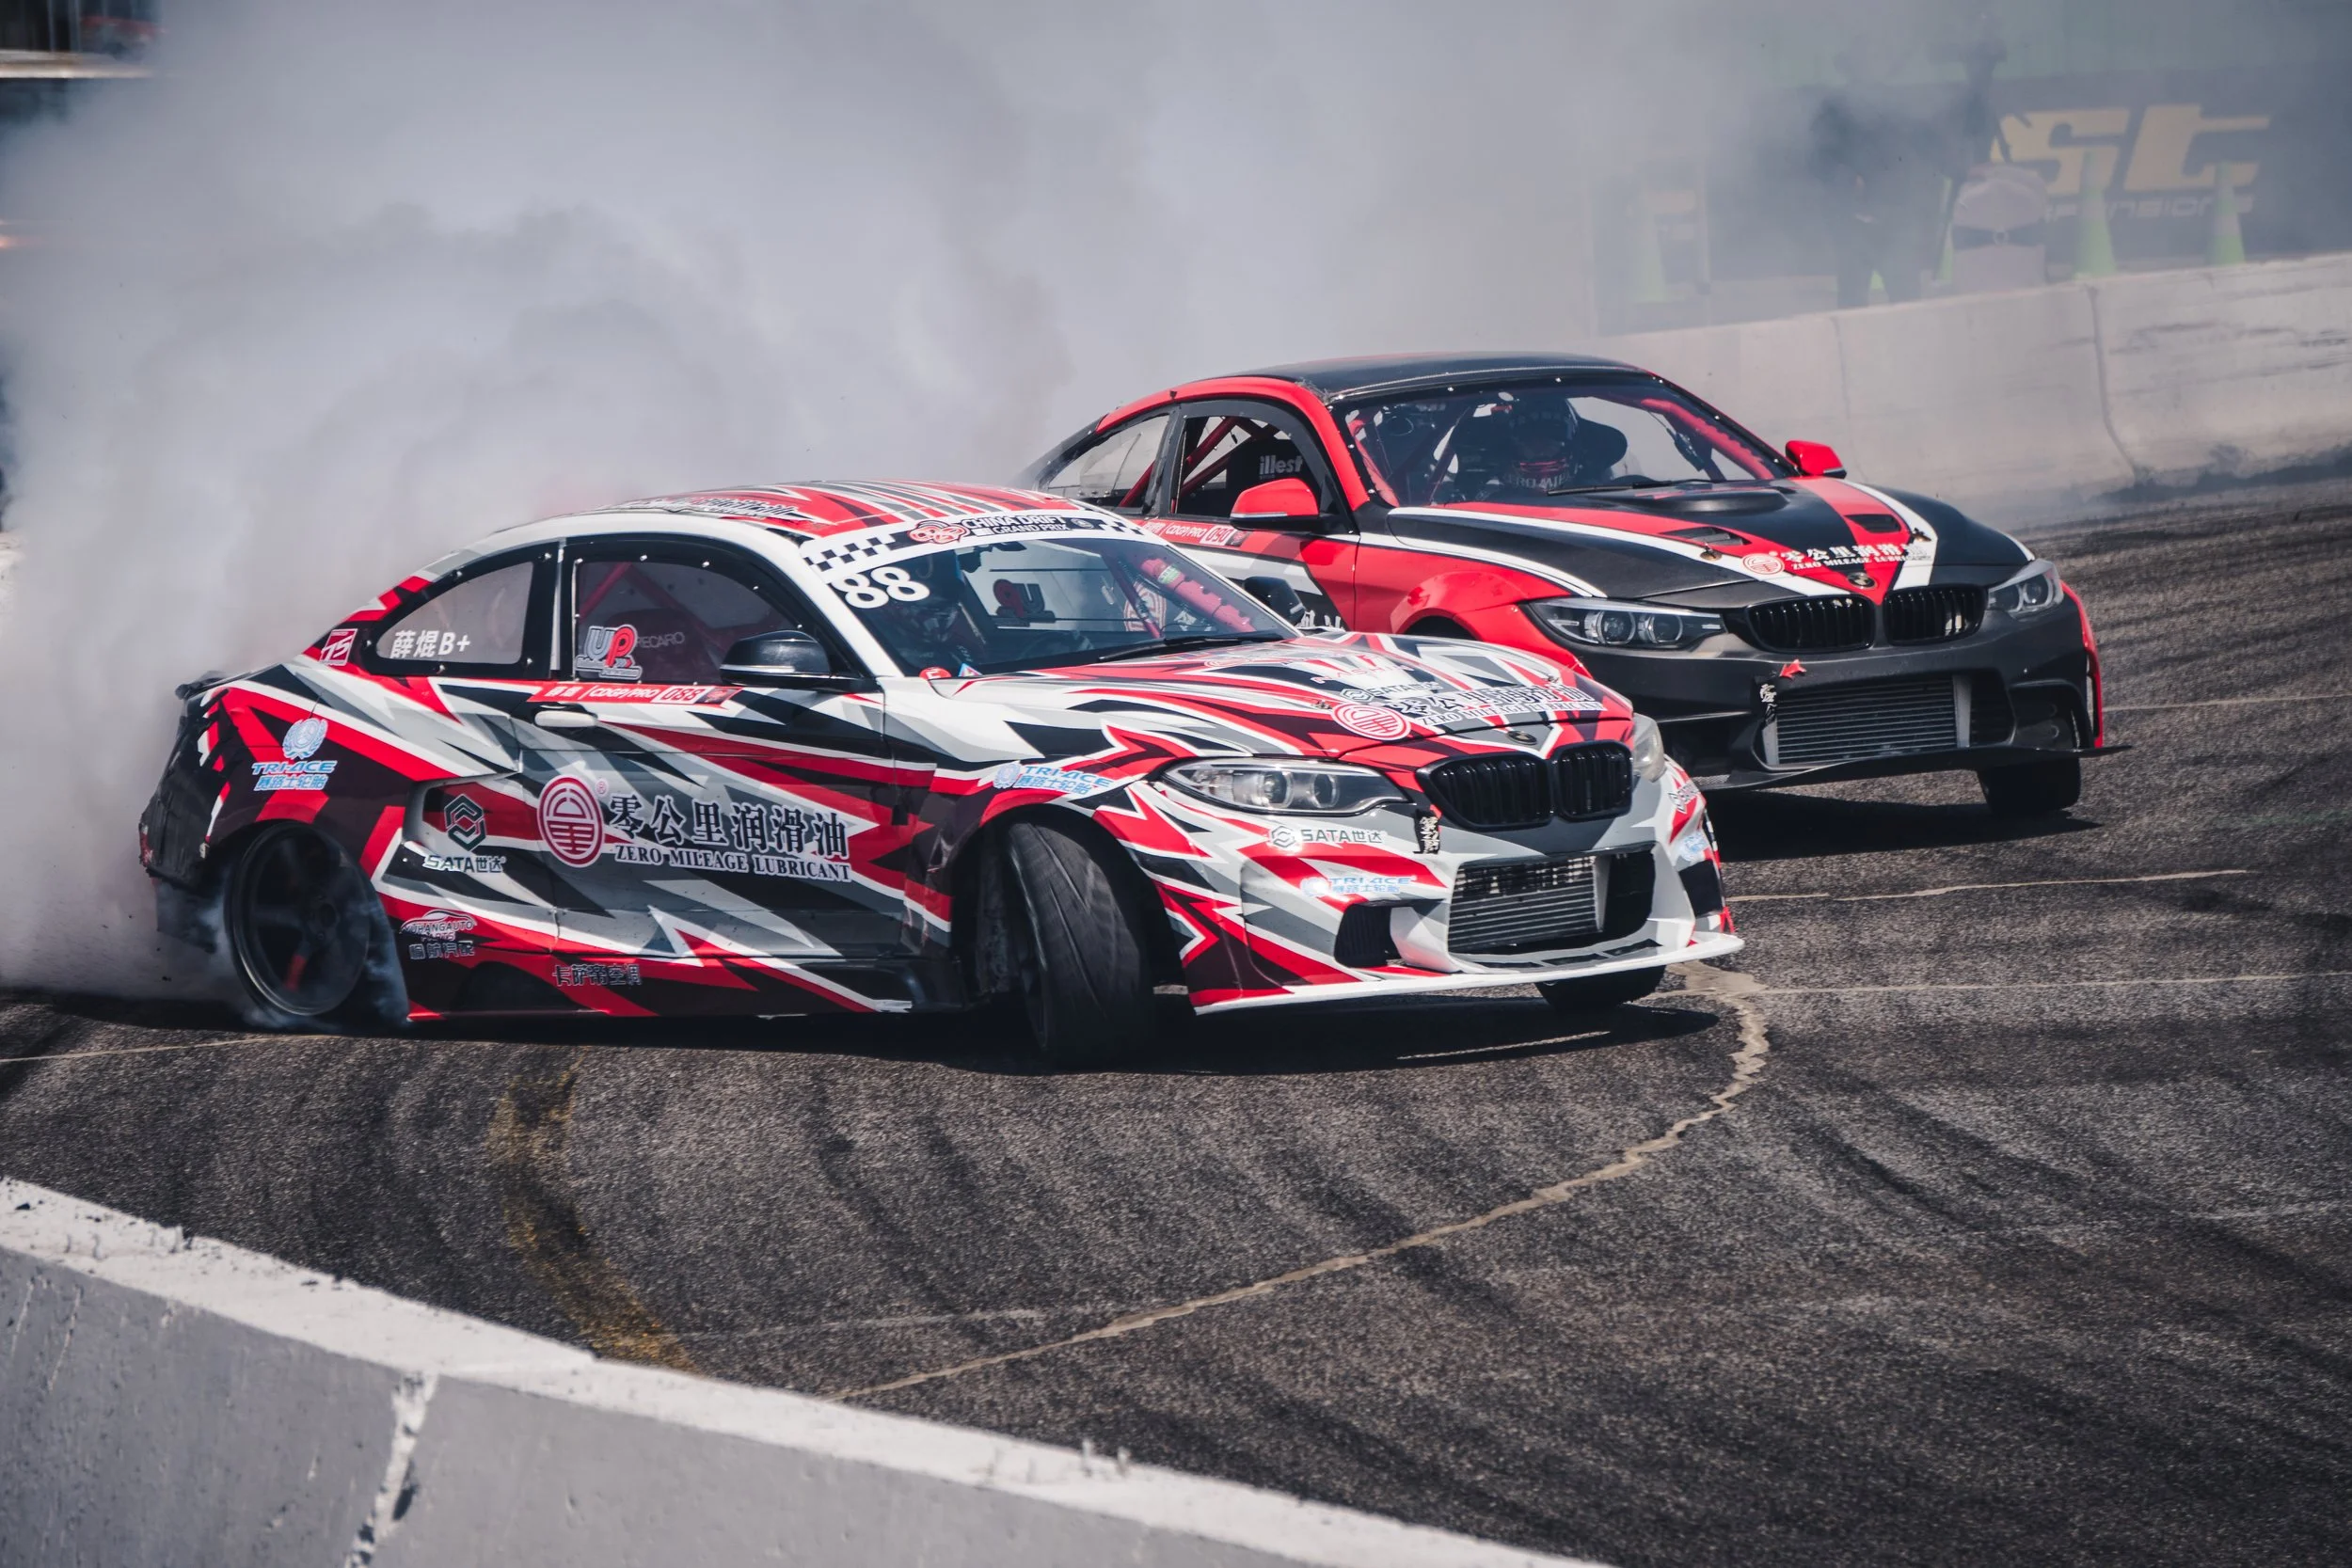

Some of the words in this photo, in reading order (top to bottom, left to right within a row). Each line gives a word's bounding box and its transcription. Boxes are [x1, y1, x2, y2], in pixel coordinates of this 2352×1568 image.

[961, 517, 1017, 529] CHINA
[1019, 515, 1067, 526] DRIFT
[994, 525, 1037, 535] GRAND
[1038, 524, 1072, 532] PRIX
[831, 566, 930, 610] 88
[585, 625, 638, 668] UP
[1421, 712, 1459, 726] ZERO
[1462, 705, 1526, 719] MILEAGE
[610, 794, 849, 858] 零公里润滑油
[615, 845, 662, 865] ZERO
[669, 847, 749, 871] MILEAGE
[755, 854, 850, 881] LUBRICANT
